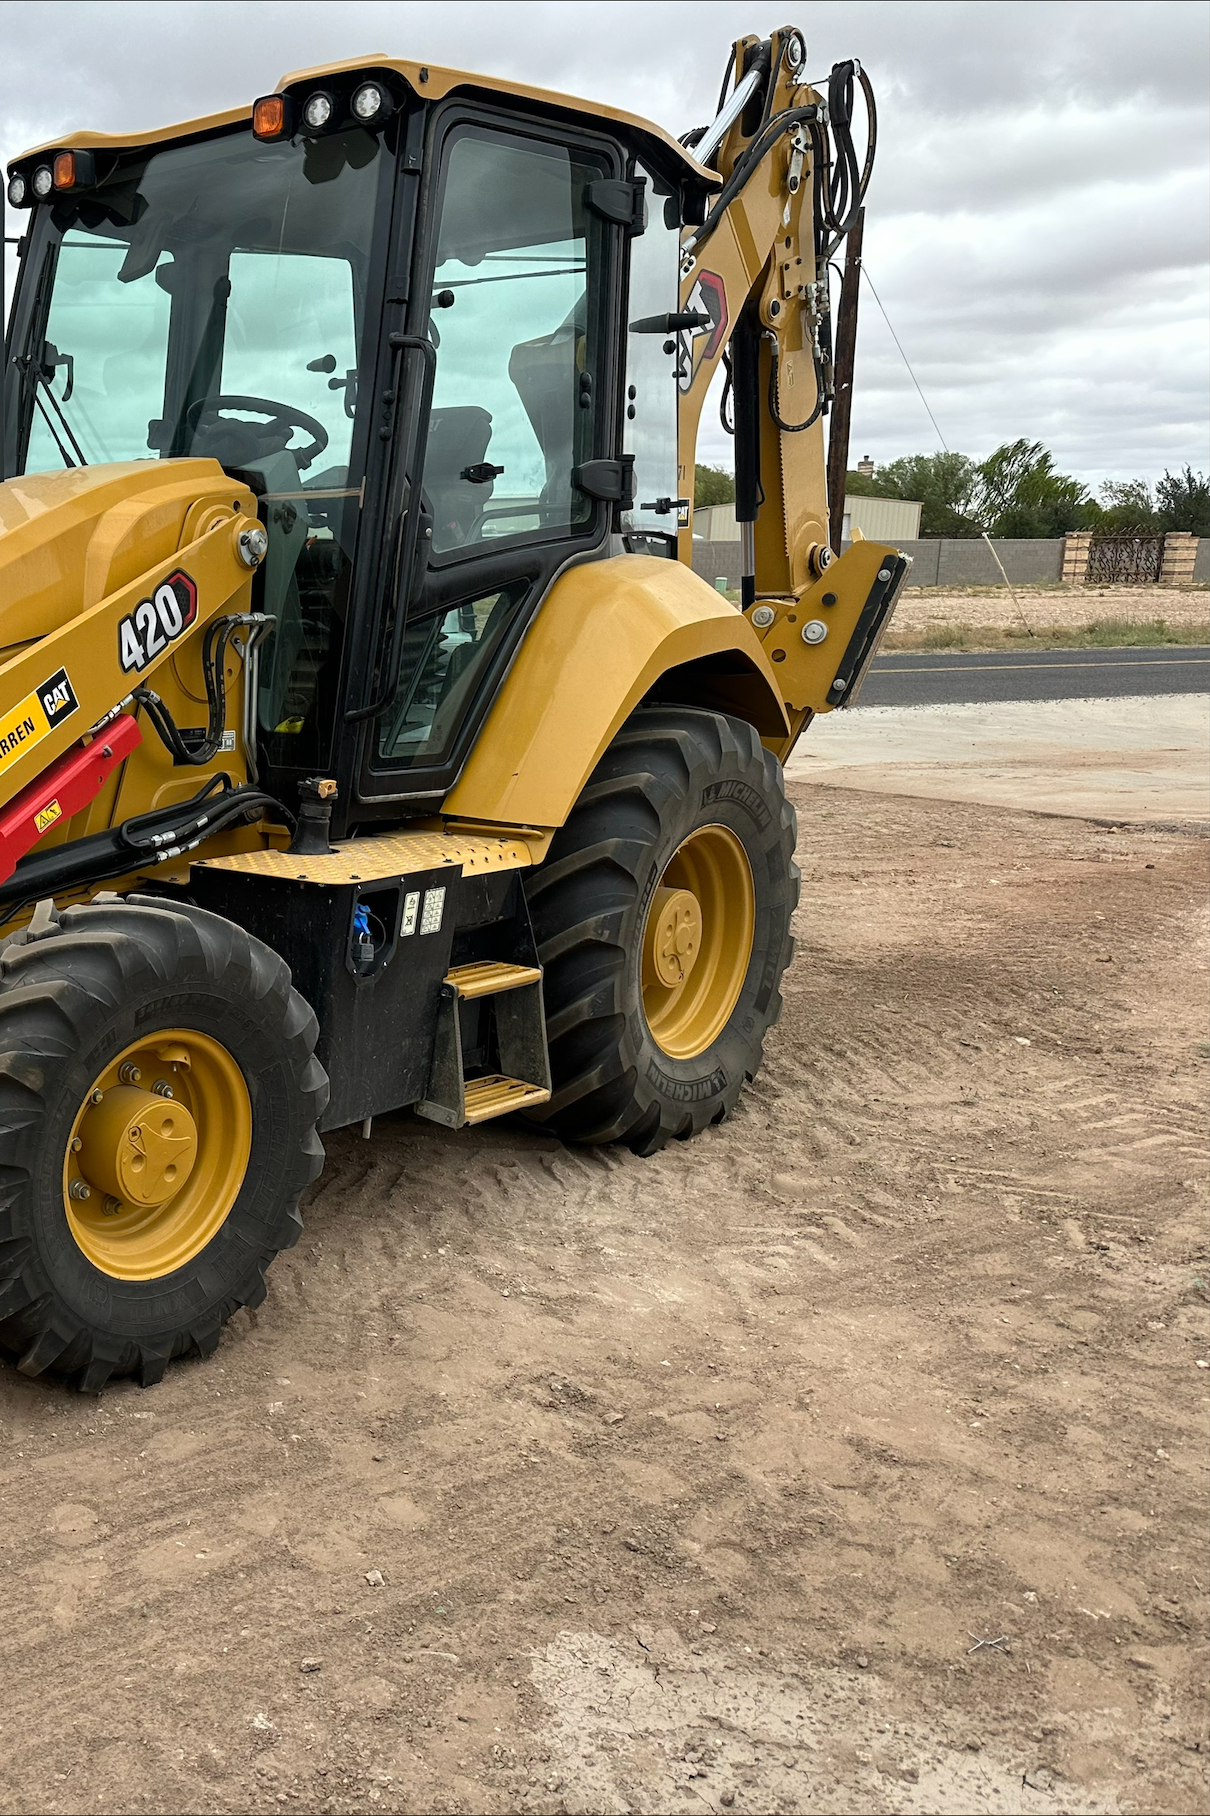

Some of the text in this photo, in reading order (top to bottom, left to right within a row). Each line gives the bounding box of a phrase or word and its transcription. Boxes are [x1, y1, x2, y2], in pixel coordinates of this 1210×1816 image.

[121, 584, 183, 669] 420
[43, 680, 70, 716] CAT
[718, 780, 772, 829] MICHELIN
[647, 1064, 712, 1101] MICHELIN
